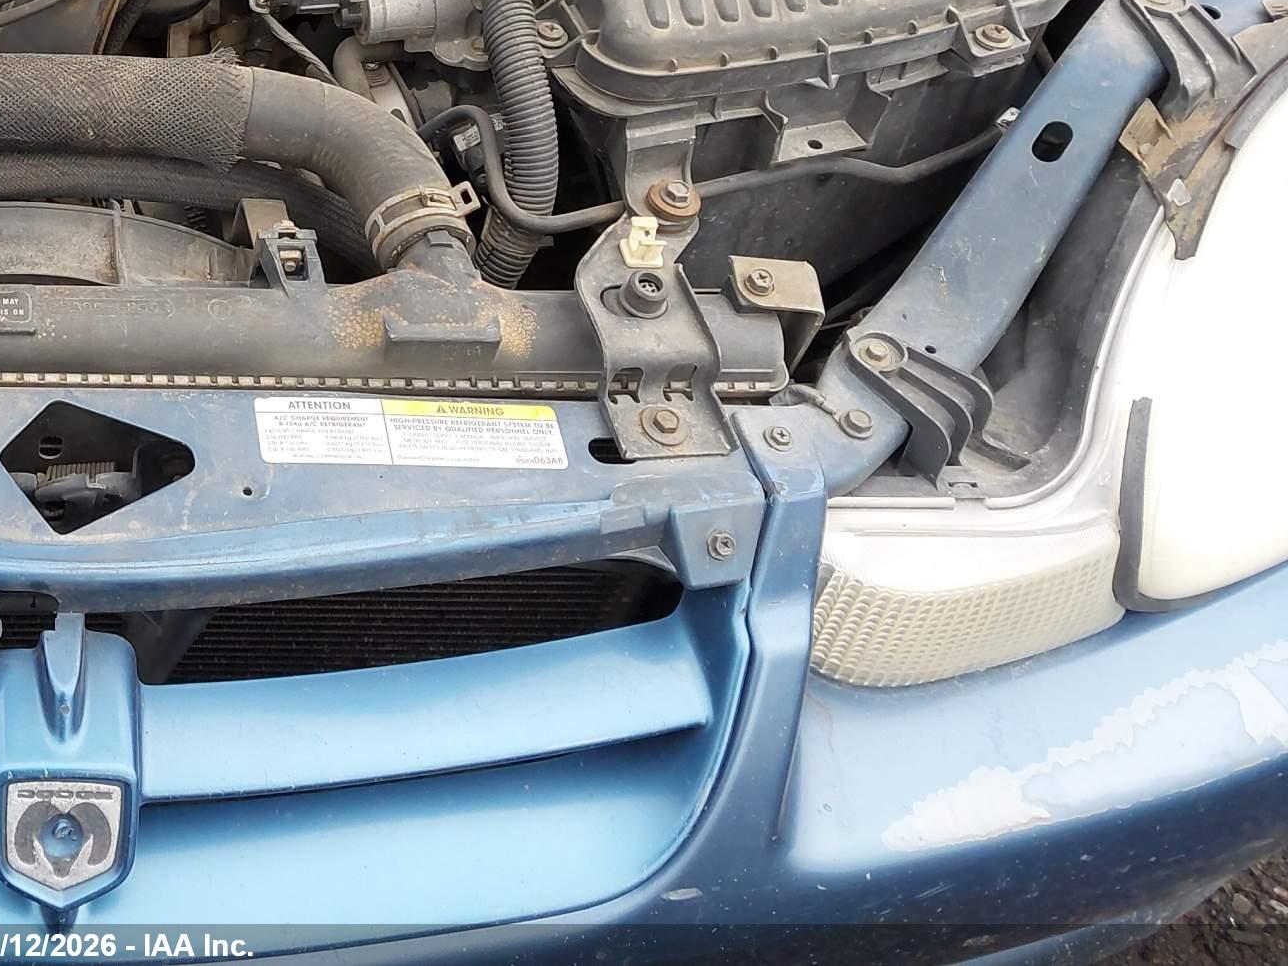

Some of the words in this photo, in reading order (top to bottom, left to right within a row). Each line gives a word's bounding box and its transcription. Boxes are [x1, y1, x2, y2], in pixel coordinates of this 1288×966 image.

[2, 297, 19, 305] MAY
[288, 400, 352, 410] ATTENTION
[447, 405, 505, 416] WARNING
[390, 417, 448, 426] HIGH-PRESSURE
[450, 418, 501, 428] REFRIGERANT
[393, 424, 431, 432] SERVICED
[444, 425, 484, 433] QUALIFIED
[486, 427, 530, 435] PERSONNEL
[17, 789, 113, 800] DODGE
